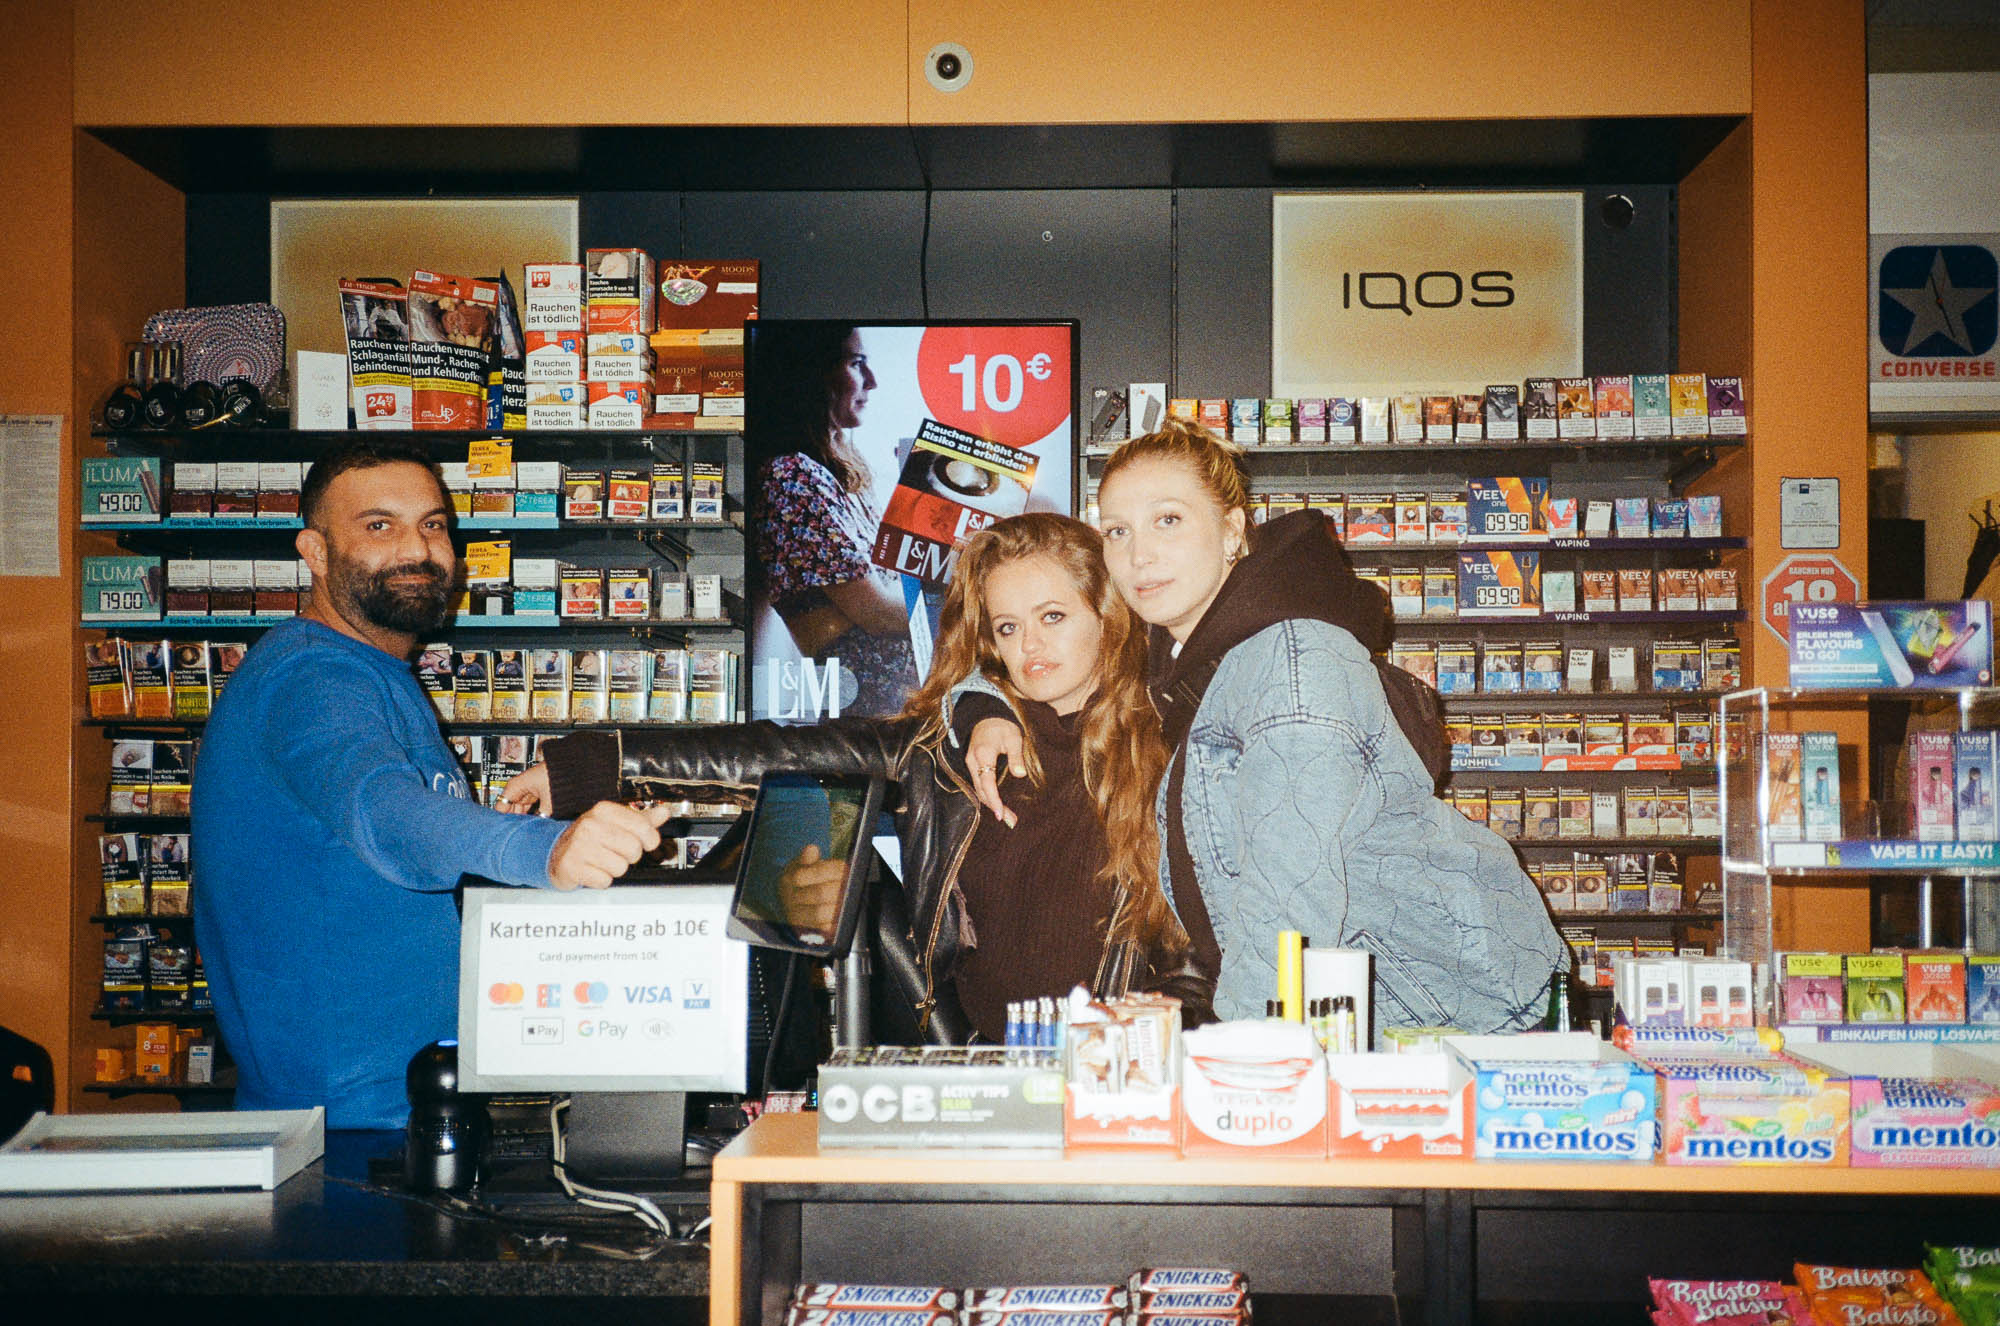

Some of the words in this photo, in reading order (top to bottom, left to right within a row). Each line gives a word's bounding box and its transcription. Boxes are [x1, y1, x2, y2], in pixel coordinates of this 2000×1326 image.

[1344, 271, 1514, 316] IQOS
[531, 303, 576, 312] Rauchen
[528, 315, 540, 323] ist
[544, 314, 578, 323] tödlich
[351, 339, 391, 350] Rauchen
[412, 343, 452, 352] Rauchen
[412, 355, 446, 365] Mund-,
[534, 360, 571, 368] Rauchen
[412, 366, 430, 376] und
[545, 368, 573, 377] tödlich
[605, 369, 633, 377] tödlich
[1881, 362, 1995, 376] CONVERSE
[545, 418, 573, 426] tödlich
[607, 419, 635, 427] tödlich
[925, 423, 973, 443] Rauchen
[975, 439, 1012, 456] erhöht
[1013, 449, 1034, 464] das
[922, 431, 956, 449] Risiko
[957, 443, 972, 454] zu
[973, 447, 1027, 471] erblinden
[86, 467, 143, 482] ILUMA
[1474, 490, 1508, 500] VEEV
[101, 495, 142, 511] 49.00
[1659, 505, 1687, 513] VEEV
[1487, 514, 1529, 531] 09.90
[1555, 540, 1590, 548] VAPING
[896, 535, 953, 584] L&M
[87, 566, 147, 581] ILUMA
[1465, 564, 1499, 574] VEEV
[1620, 571, 1649, 579] VEEV
[1668, 571, 1698, 579] VEEV
[1705, 571, 1736, 579] VEEV
[103, 593, 142, 609] 79.00
[1477, 588, 1520, 605] 09.90
[1797, 608, 1839, 619] vuse
[1797, 639, 1863, 649] FLAVOURS
[1797, 651, 1815, 660] TO
[1818, 650, 1840, 660] GO!
[768, 658, 840, 718] L&M
[1870, 845, 1917, 859] VAPE
[1920, 845, 1938, 859] IT
[1942, 844, 1993, 859] EASY!
[489, 921, 636, 940] Kartenzahlung
[643, 919, 666, 936] ab
[674, 919, 709, 936] 10€
[539, 953, 562, 961] Card
[565, 953, 609, 963] payment
[613, 952, 638, 961] from
[642, 952, 659, 961] 10€
[624, 986, 672, 1004] VISA
[537, 1025, 559, 1037] Pay
[599, 1020, 628, 1038] Pay
[1636, 1028, 1726, 1042] mentos
[1831, 1030, 1906, 1041] EINKAUFEN
[1910, 1030, 1937, 1041] UND
[822, 1084, 937, 1123] OCB
[1216, 1110, 1293, 1136] duplo
[1496, 1128, 1636, 1151] mentos
[1872, 1122, 2000, 1147] mento
[1688, 1135, 1832, 1160] mentos
[1151, 1271, 1234, 1285] SNICKERS
[1813, 1268, 1905, 1290] Balisto
[838, 1287, 933, 1303] SNICKERS
[1010, 1288, 1103, 1305] SNICKERS
[1668, 1281, 1761, 1302] Balisto
[1152, 1294, 1236, 1307] SNICKERS
[831, 1312, 929, 1326] SNICKERS
[1007, 1314, 1101, 1326] SNICKERS
[1842, 1304, 1937, 1326] Balisto
